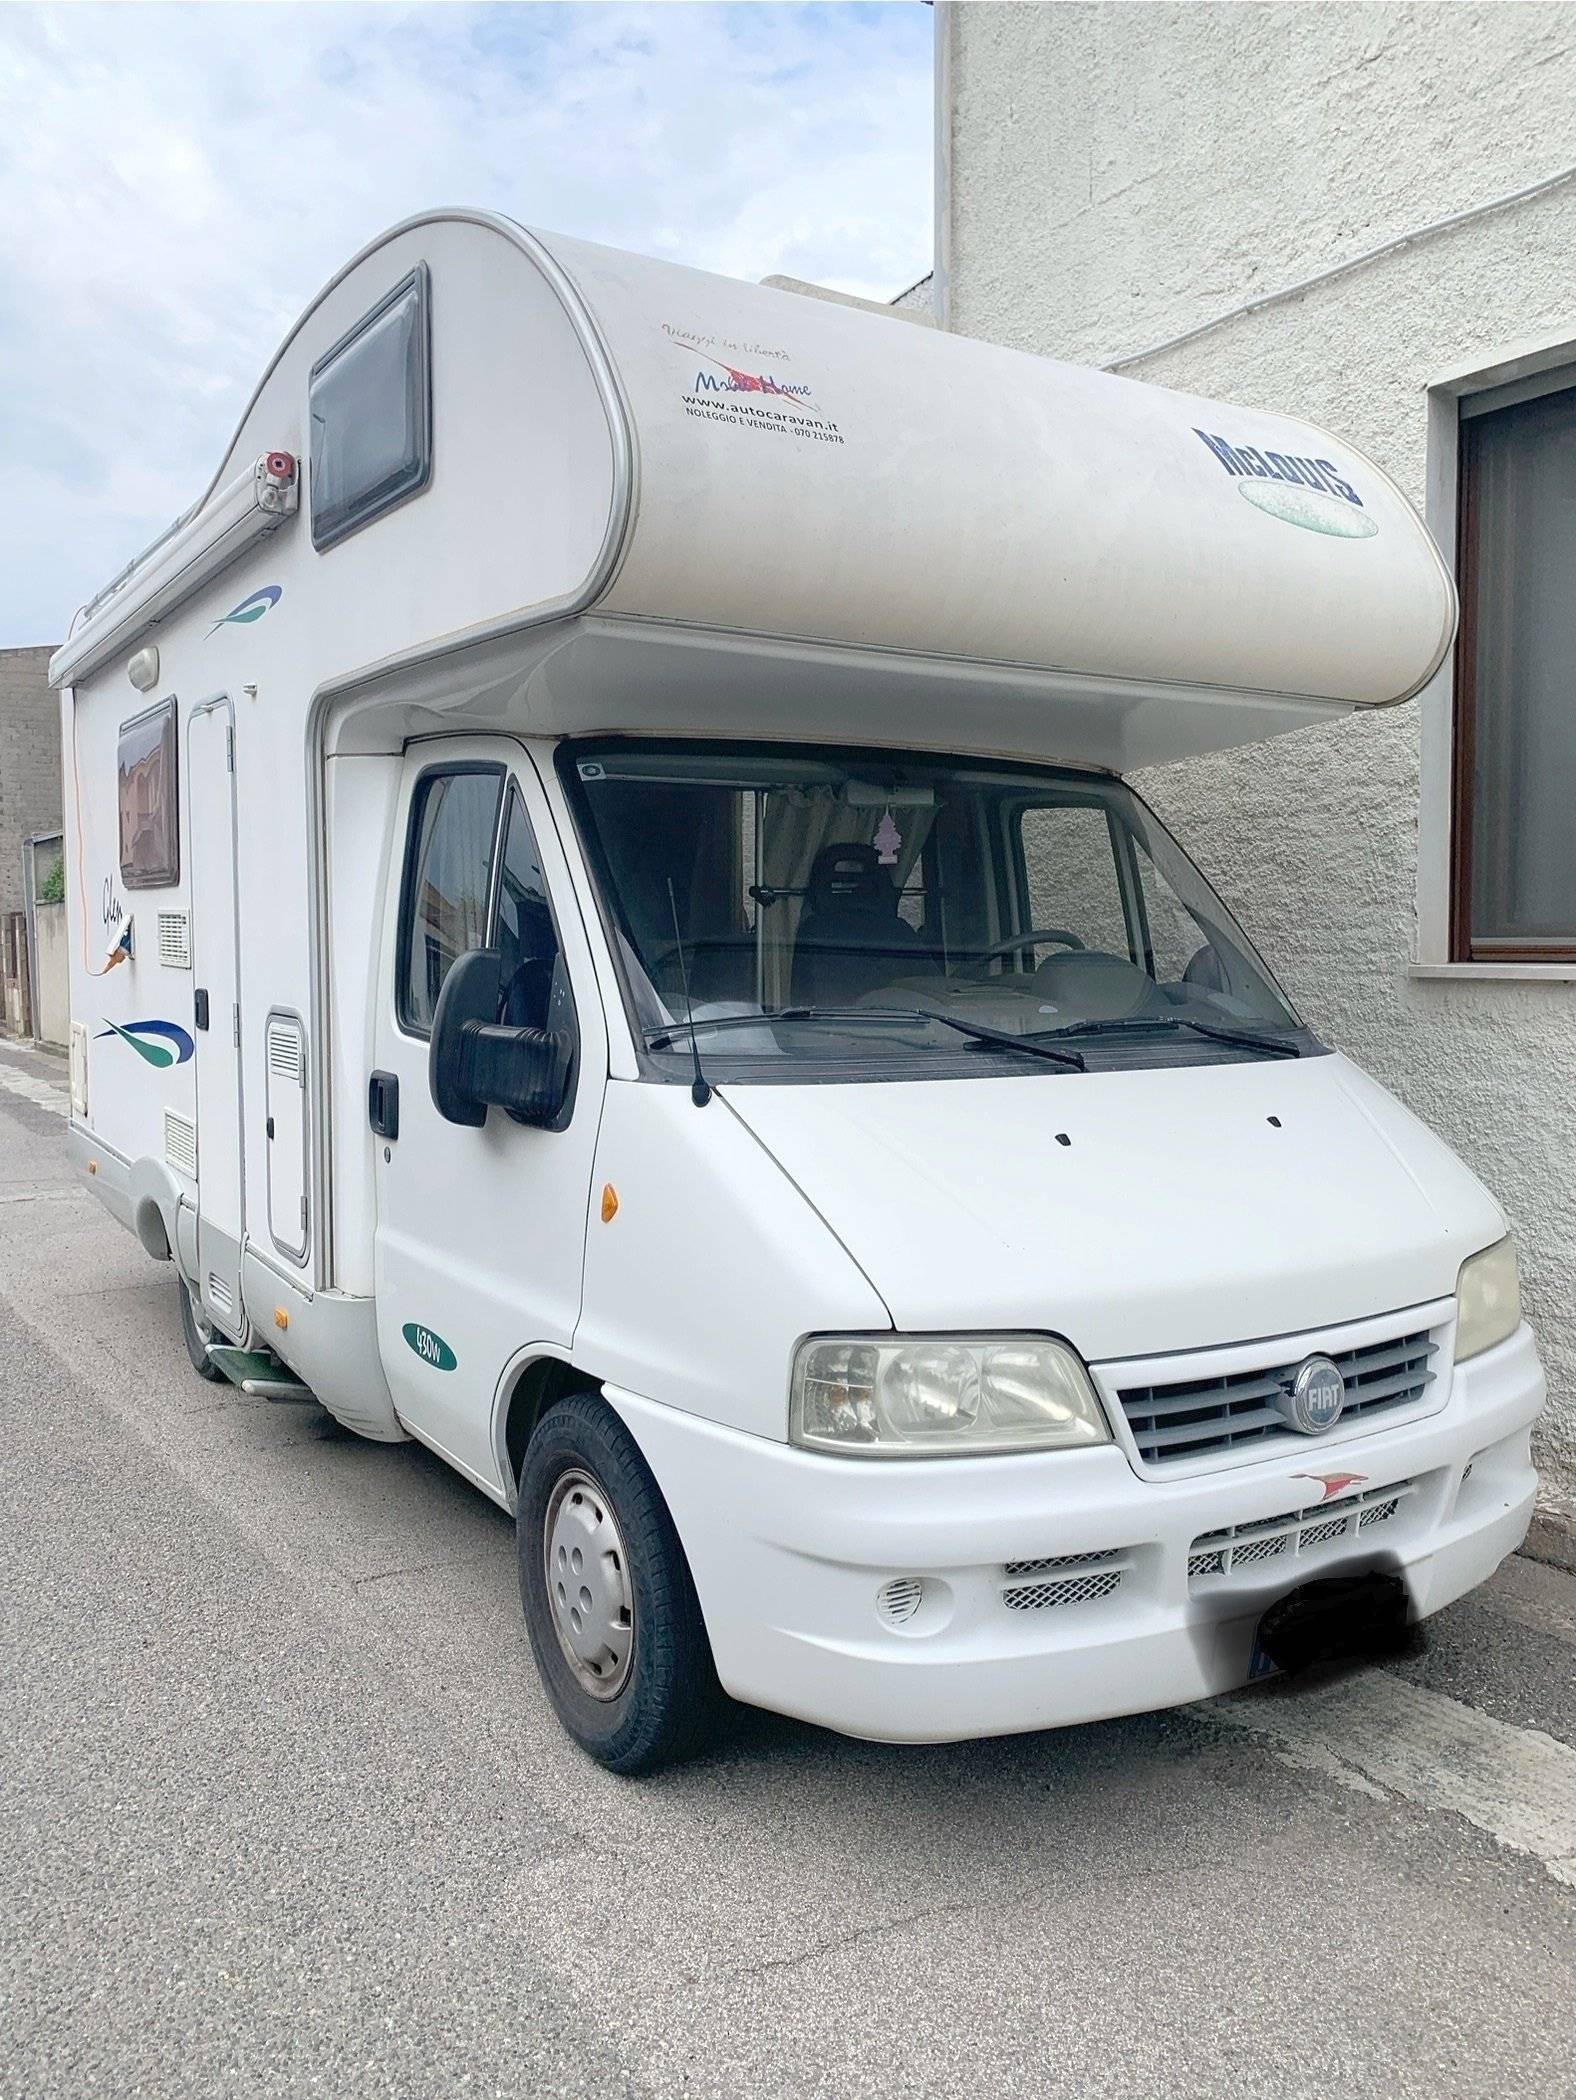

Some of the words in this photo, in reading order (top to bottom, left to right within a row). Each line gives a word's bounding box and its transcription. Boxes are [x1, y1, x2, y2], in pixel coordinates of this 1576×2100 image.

[681, 395, 839, 432] www.autocaravan.it
[686, 407, 736, 424] NOLEGGIO
[739, 417, 746, 426] E
[748, 418, 787, 433] VENDITA
[794, 427, 811, 438] 070
[813, 431, 845, 444] 215878
[1308, 1383, 1340, 1412] FIAT
